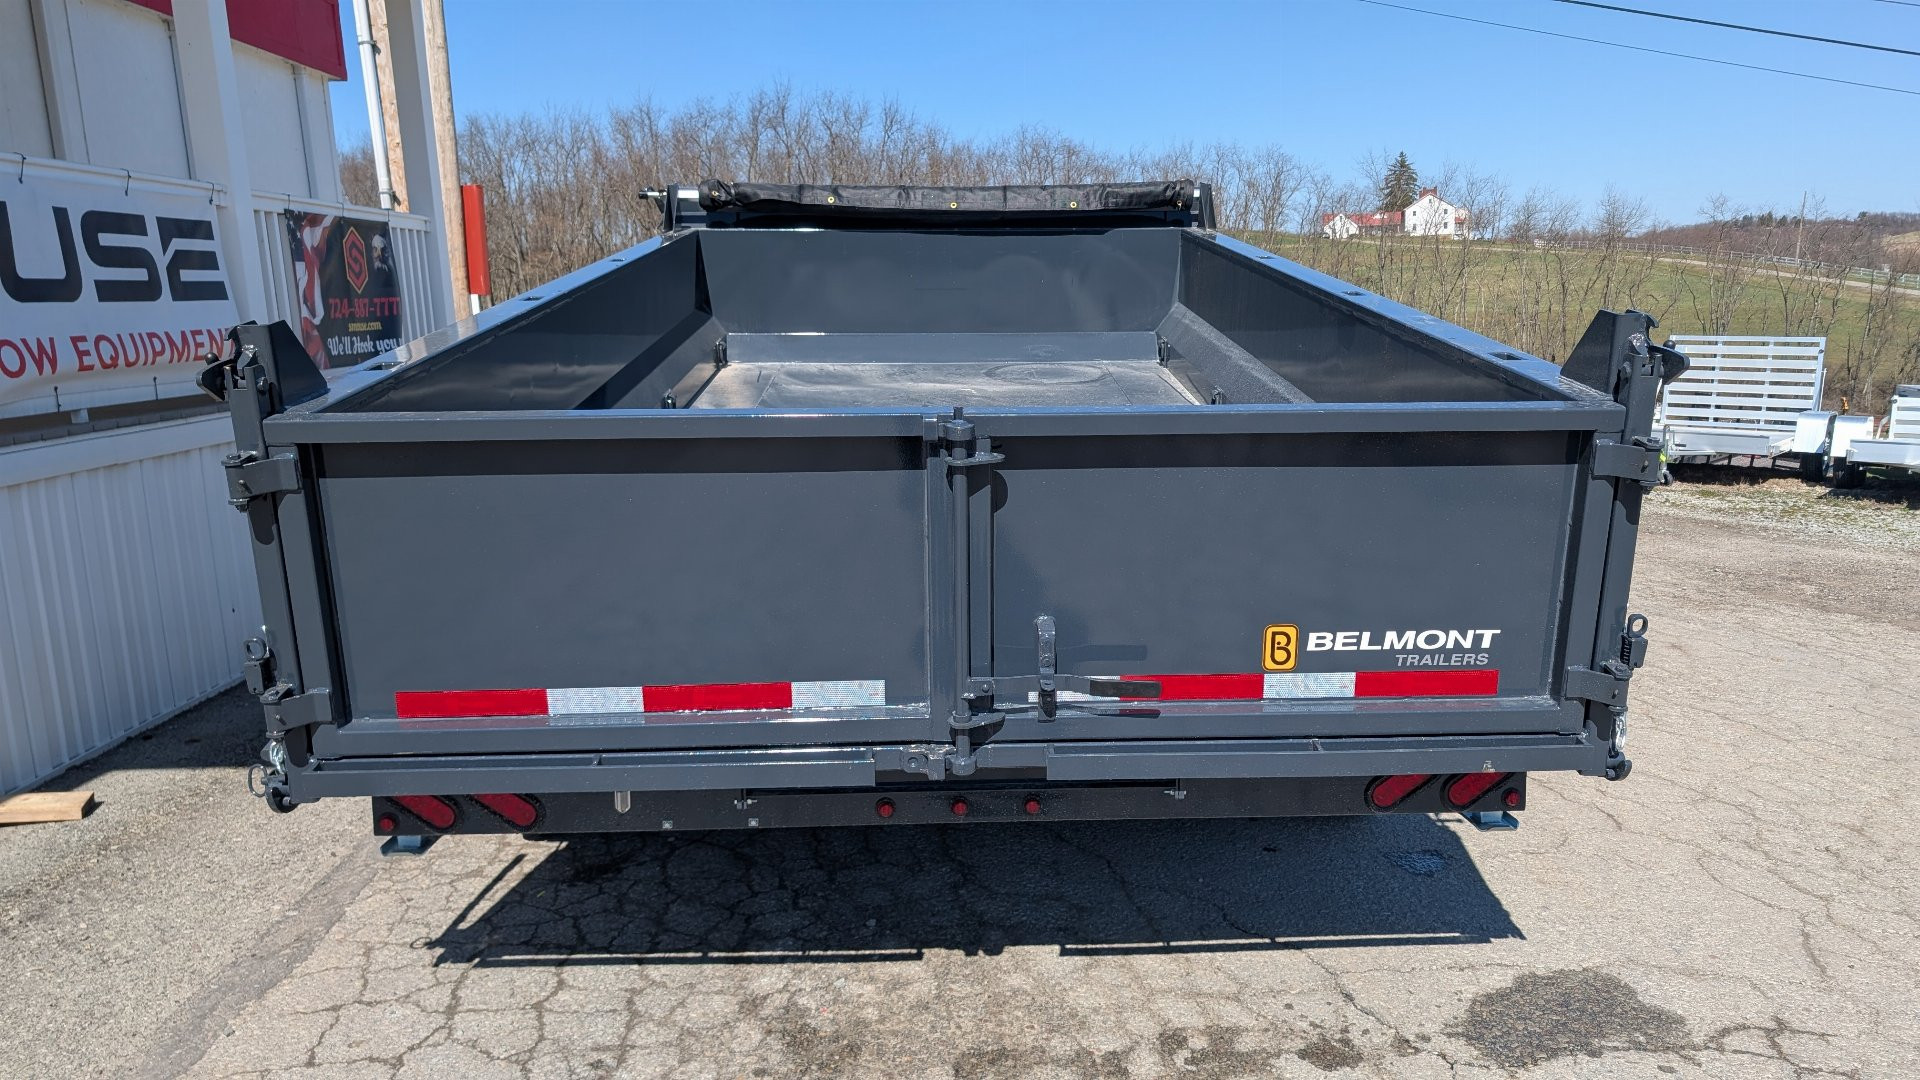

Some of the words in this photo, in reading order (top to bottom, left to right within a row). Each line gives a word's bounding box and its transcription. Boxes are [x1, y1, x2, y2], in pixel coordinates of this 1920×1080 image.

[328, 297, 401, 320] 724-887-777
[327, 335, 352, 357] We'll
[352, 334, 375, 355] Hook
[375, 337, 398, 354] you
[0, 336, 58, 379] OW
[1306, 629, 1501, 652] BELMONT
[1395, 653, 1489, 667] TRAILERS
